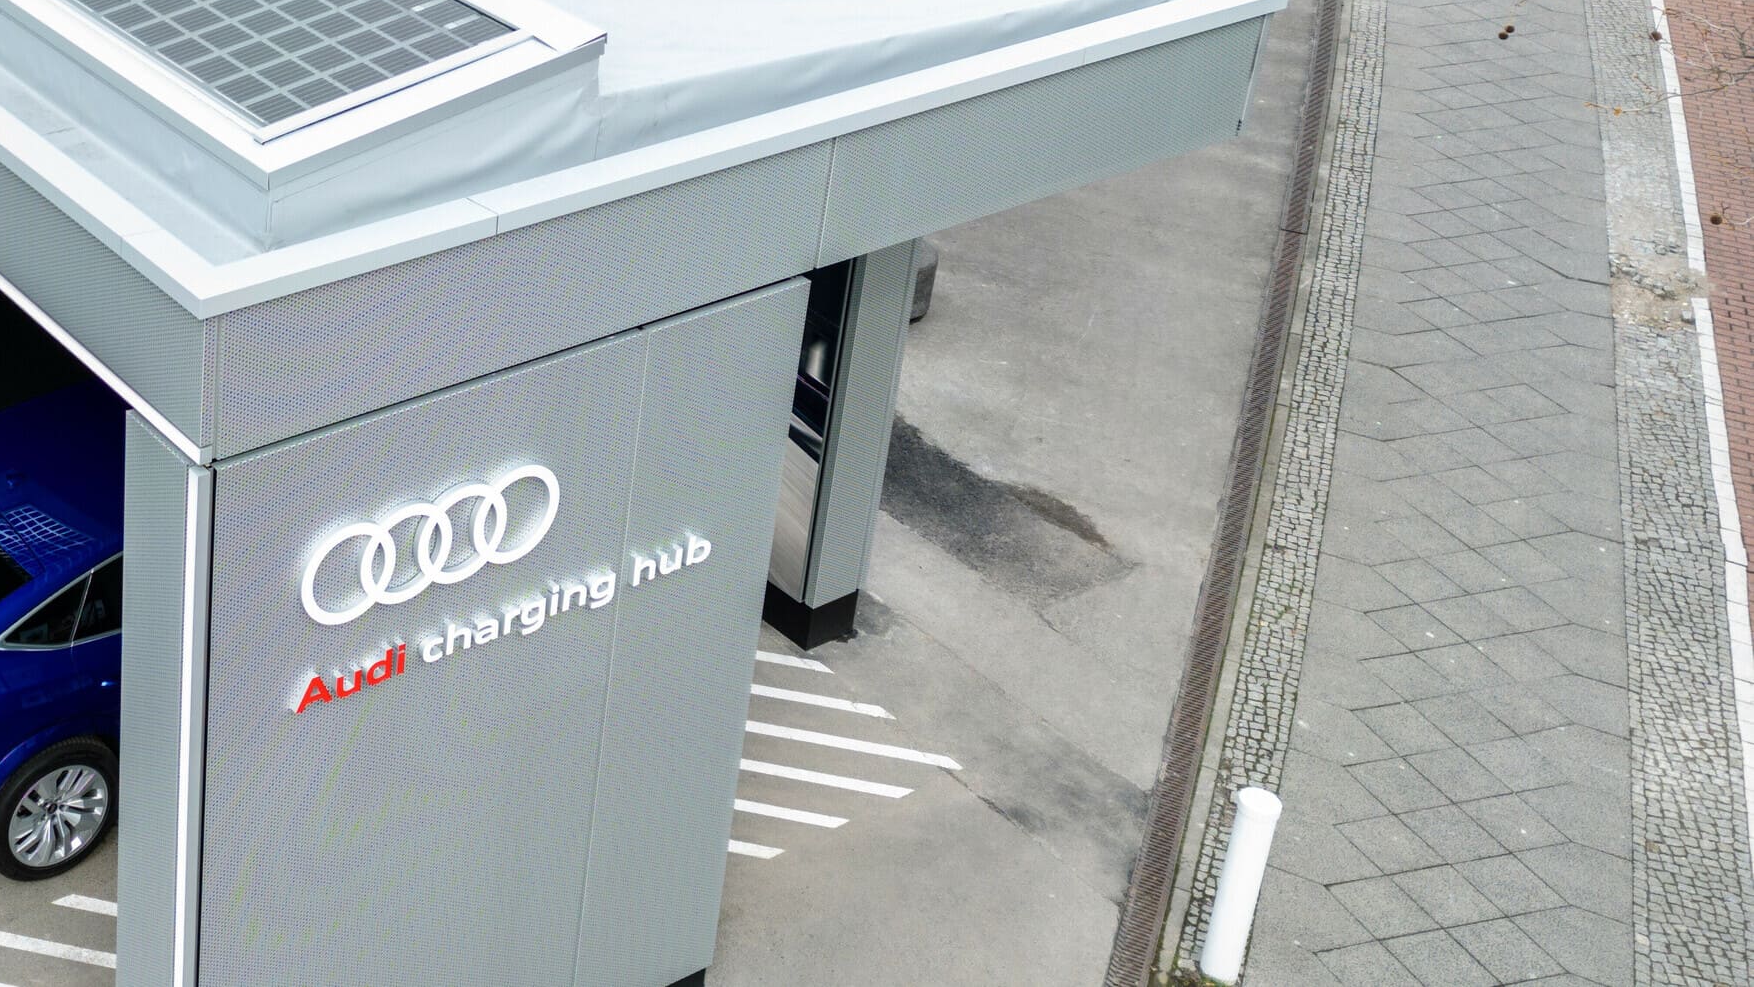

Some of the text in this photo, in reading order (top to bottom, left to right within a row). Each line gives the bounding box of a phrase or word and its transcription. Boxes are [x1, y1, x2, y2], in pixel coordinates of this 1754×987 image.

[295, 532, 713, 714] Audi charging hub
